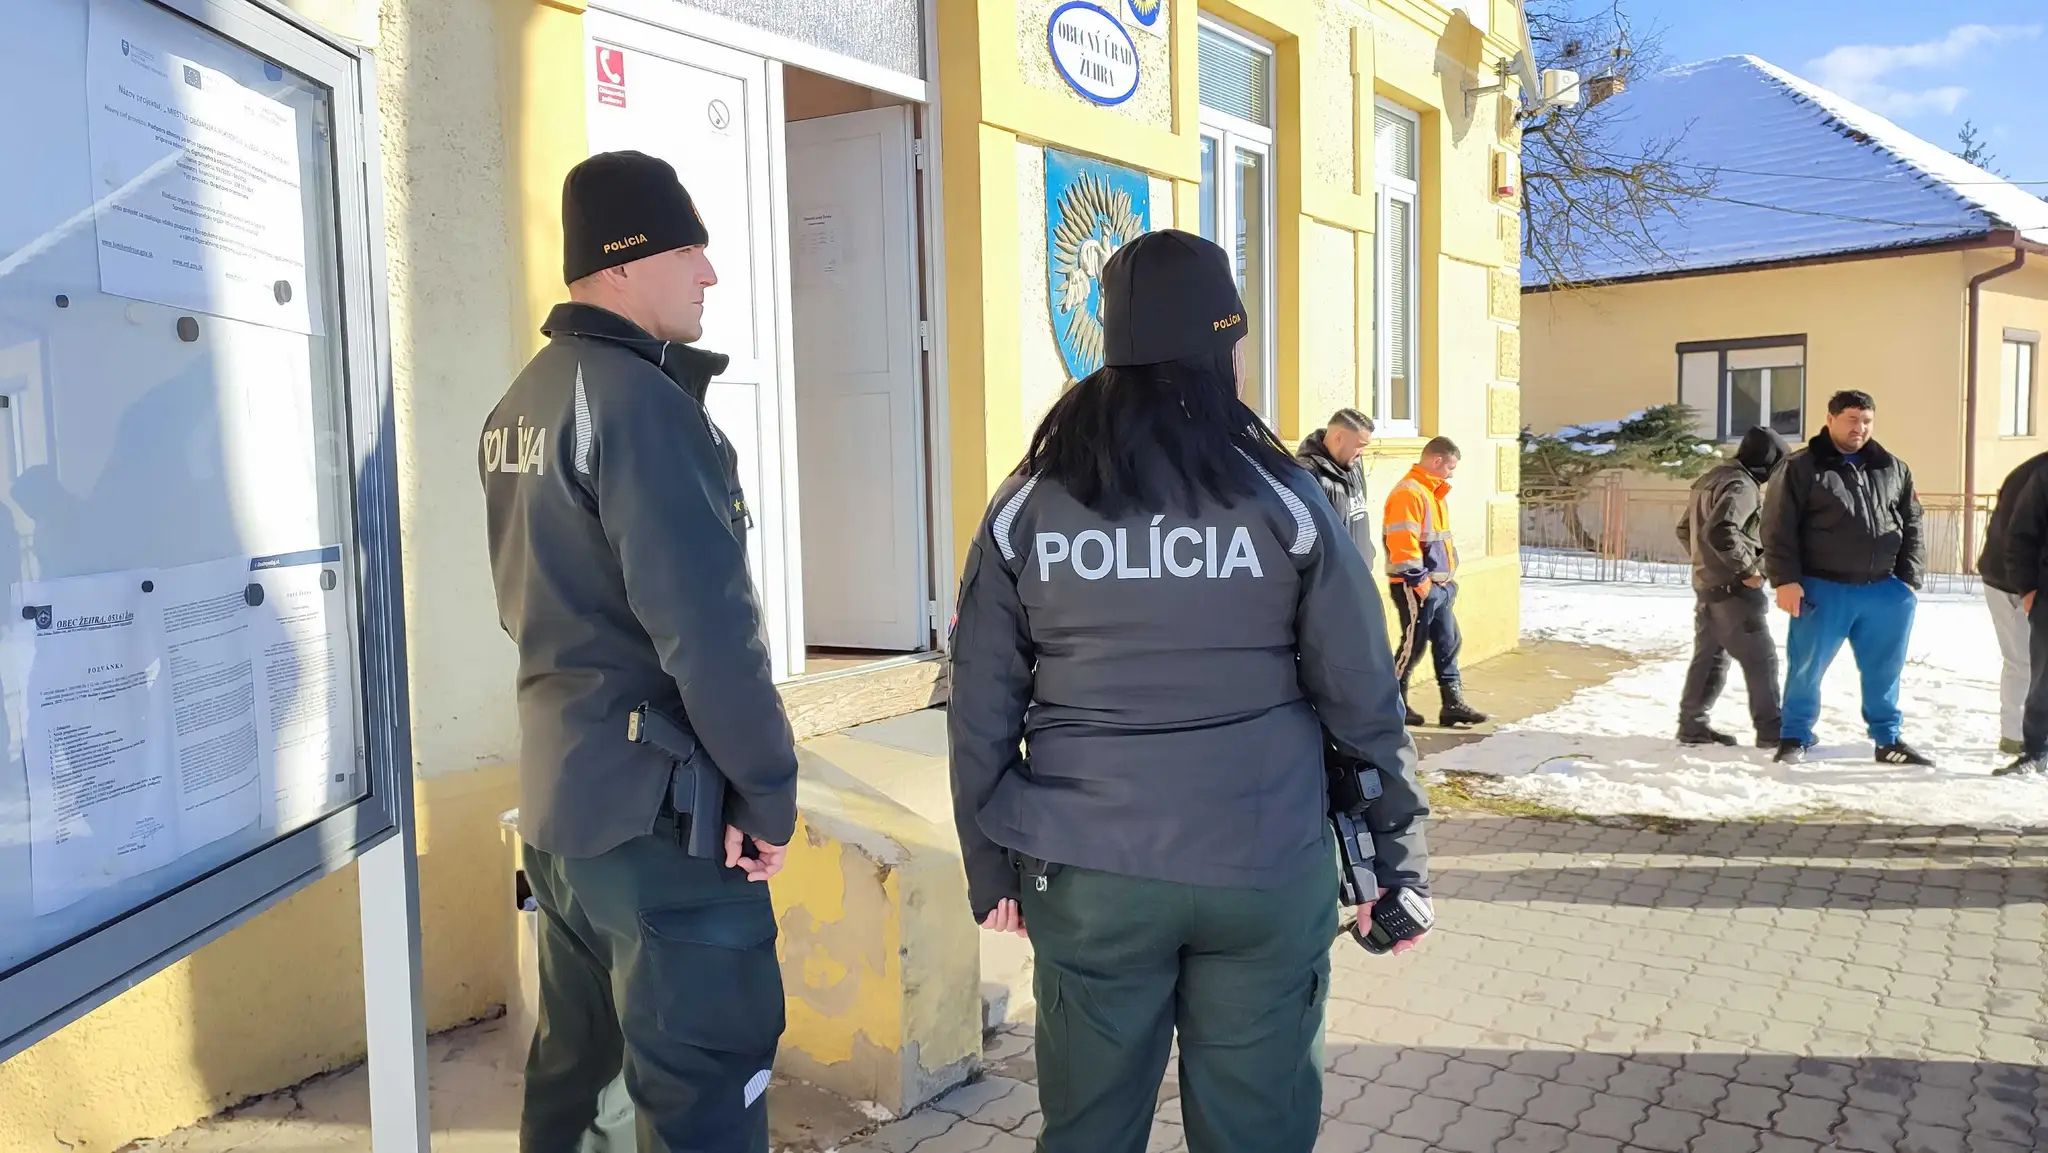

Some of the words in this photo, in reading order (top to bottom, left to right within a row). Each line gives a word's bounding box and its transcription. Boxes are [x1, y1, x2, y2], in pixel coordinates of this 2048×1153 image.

[603, 233, 648, 254] POLÍCIA
[1036, 514, 1264, 582] POLÍCIA
[56, 618, 78, 629] OBEC
[87, 662, 124, 674] POZVÁNKA
